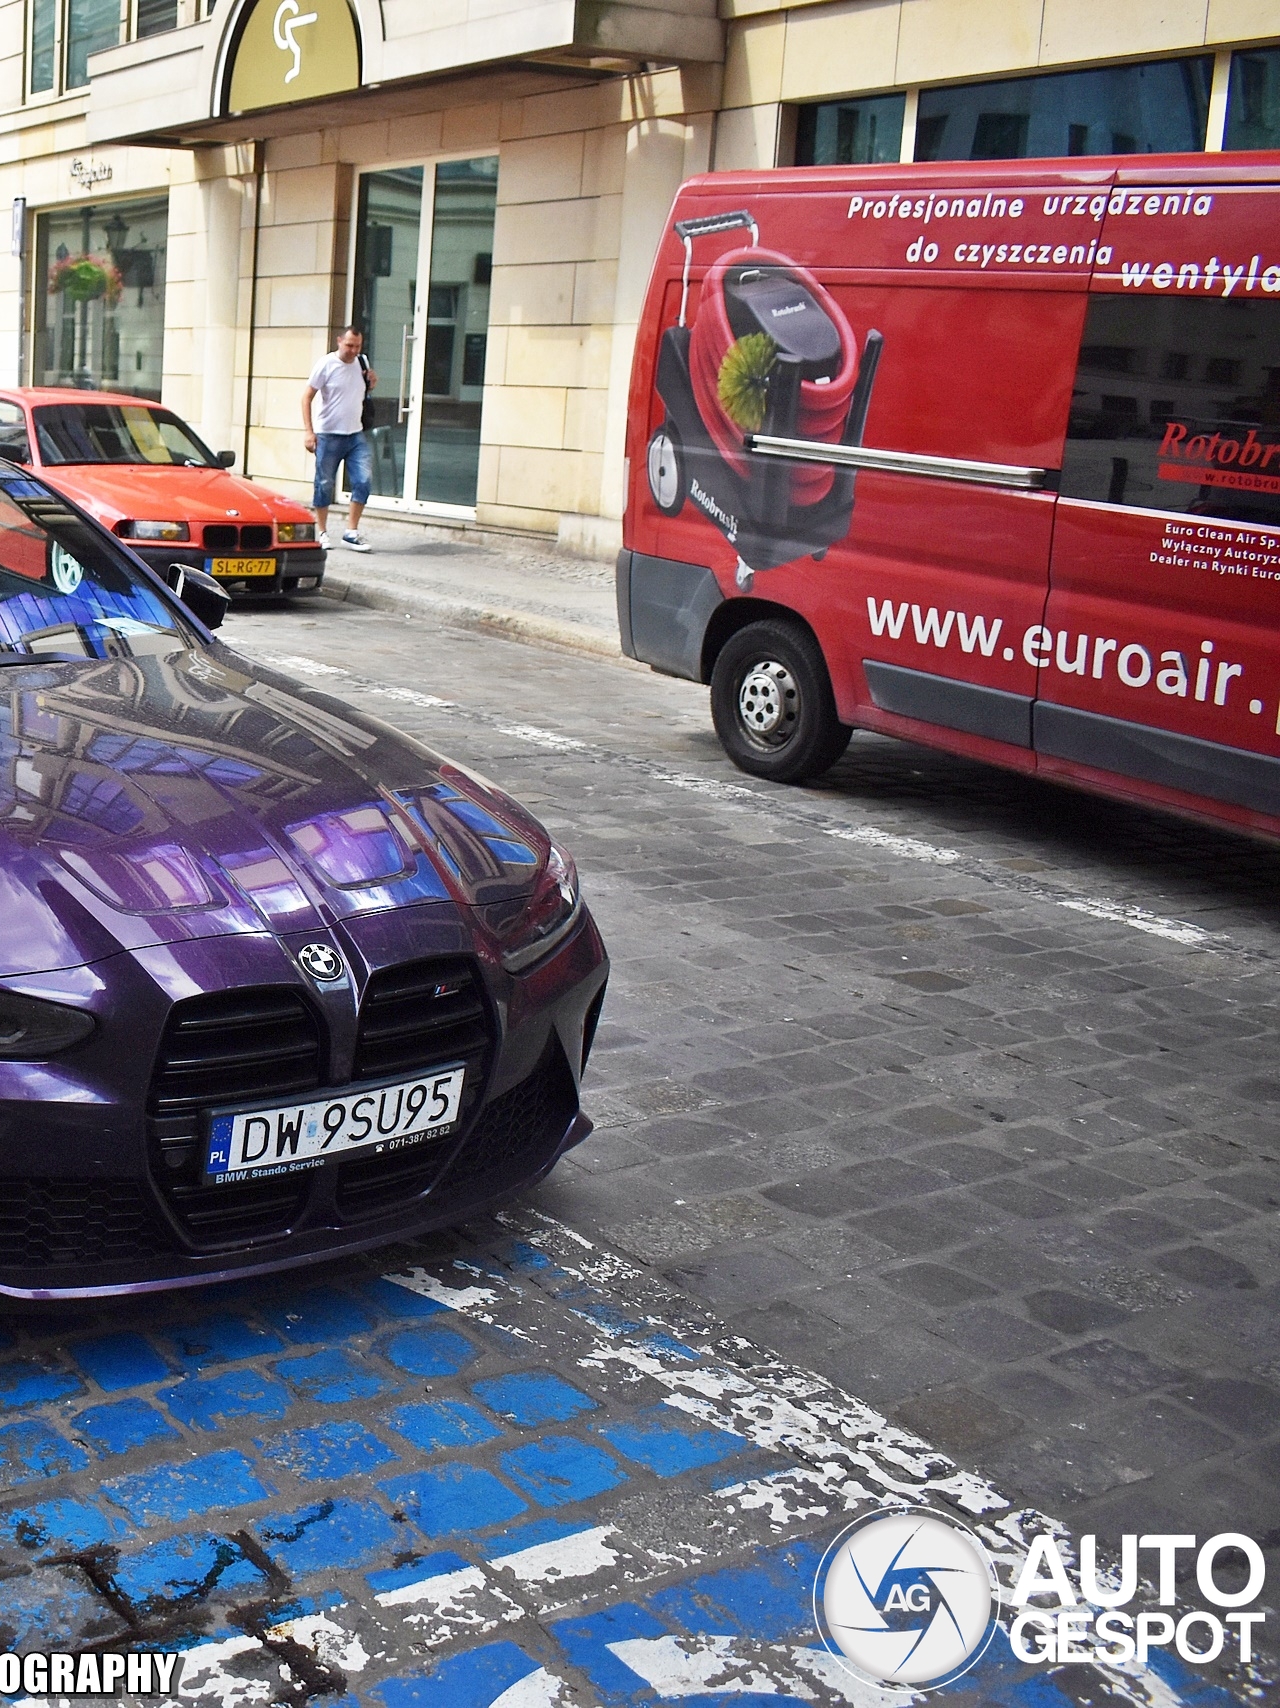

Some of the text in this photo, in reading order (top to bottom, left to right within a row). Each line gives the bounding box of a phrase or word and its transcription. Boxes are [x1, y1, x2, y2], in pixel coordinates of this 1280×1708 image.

[847, 189, 1213, 224] Profesjonalne urządzenia
[905, 235, 1280, 298] do czyszczenia wentyla
[1157, 422, 1280, 468] Rotobr
[690, 478, 738, 535] Rotobrush
[1165, 523, 1280, 549] Euro Clean Air Sp.
[1150, 552, 1280, 580] Dealer na Rynki Euro
[1162, 538, 1280, 566] Wyłączny Autoryz
[217, 560, 271, 573] SL-RG-77
[866, 596, 1280, 736] www.euroair.
[241, 1077, 452, 1163] DW 9SU95
[389, 1125, 450, 1150] 071-387 82 82
[209, 1150, 227, 1164] PL
[251, 1165, 288, 1178] Stando
[288, 1158, 325, 1172] Service
